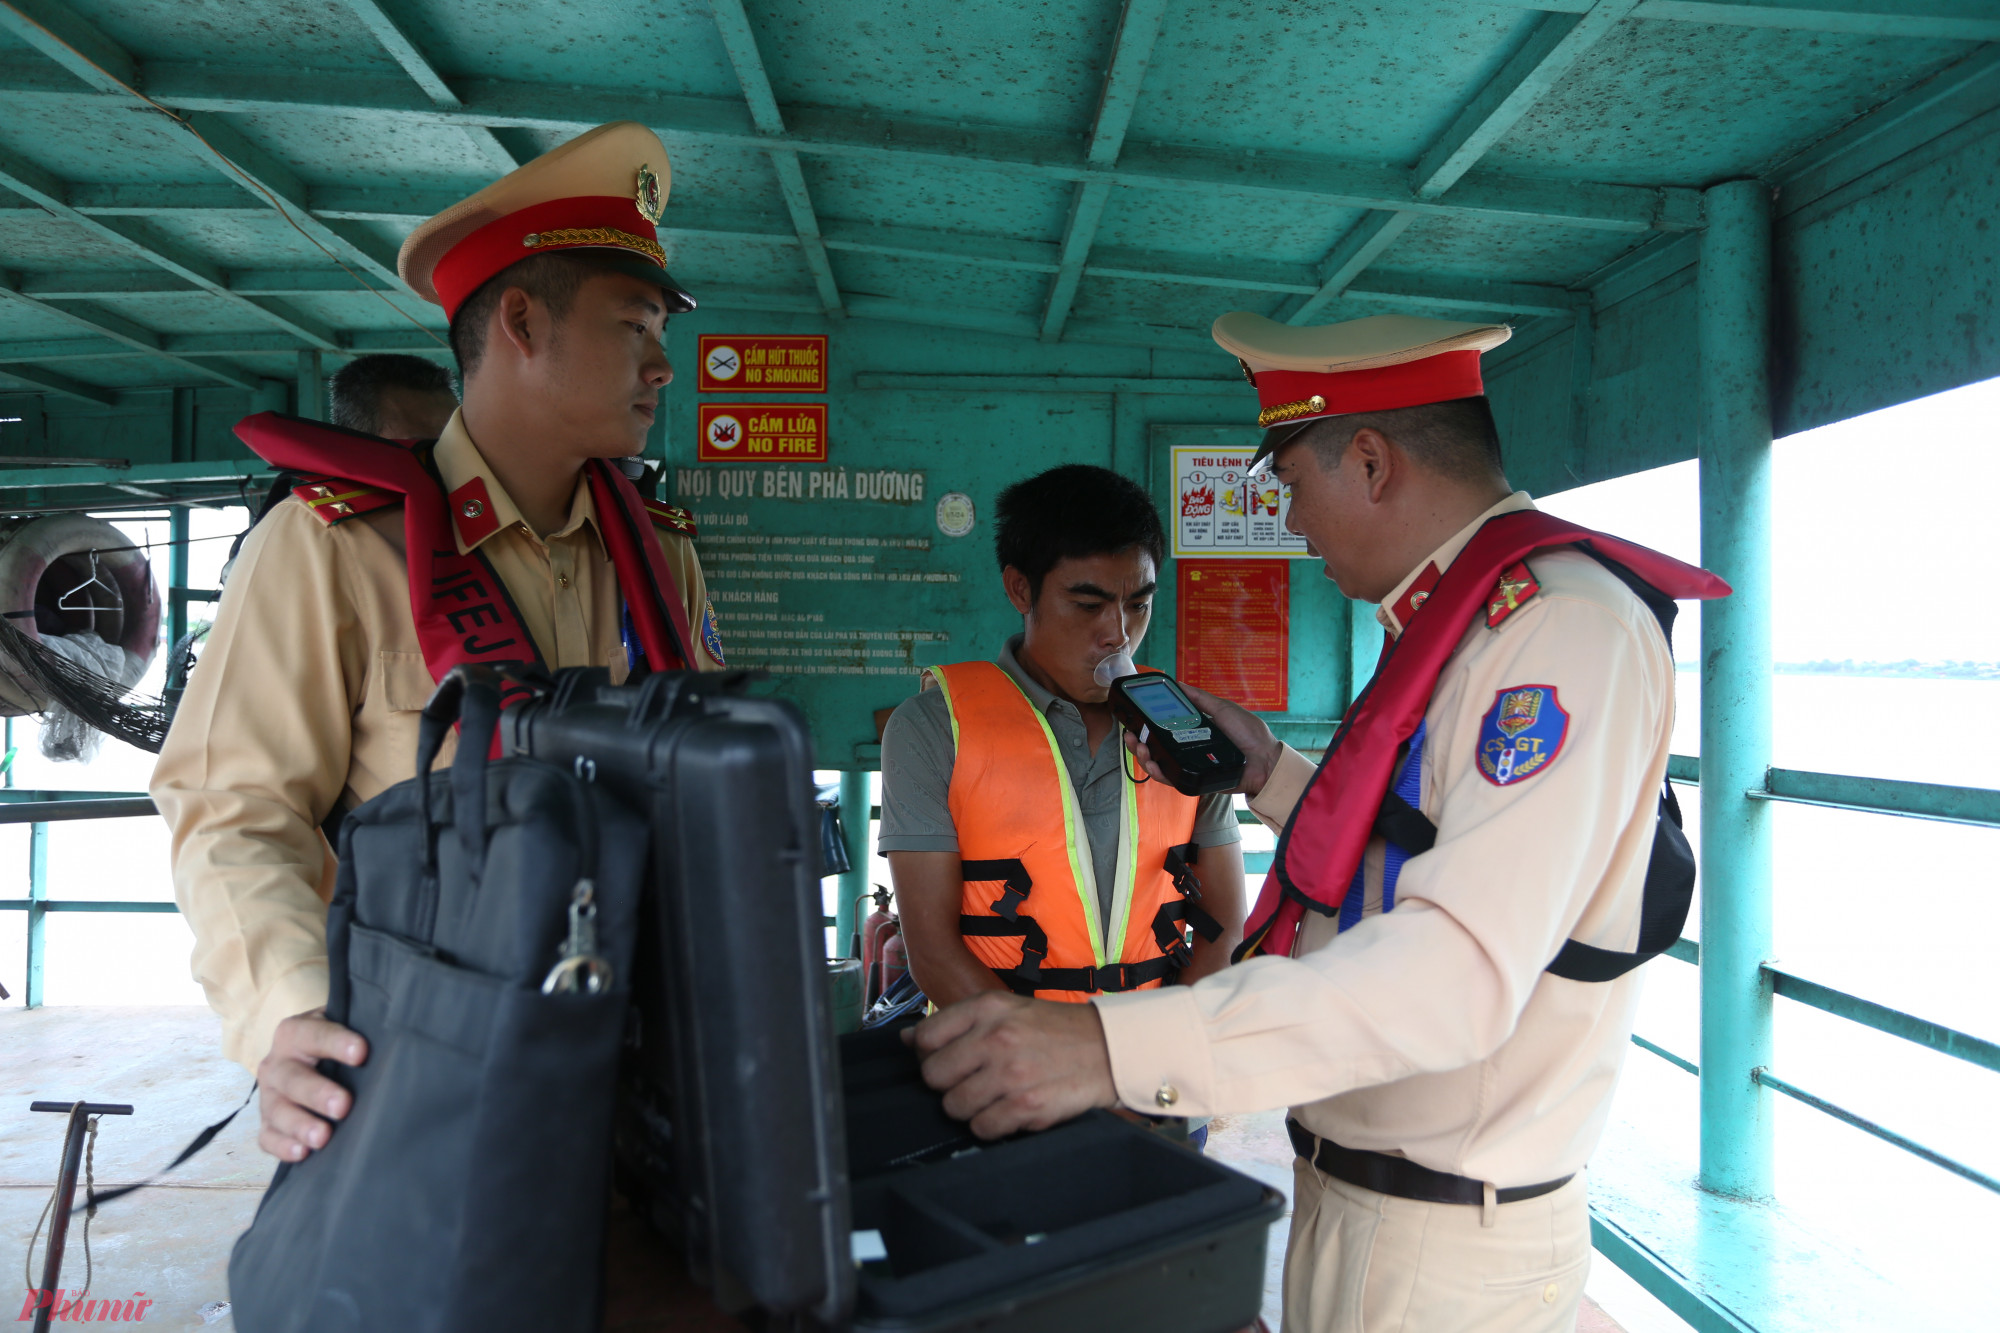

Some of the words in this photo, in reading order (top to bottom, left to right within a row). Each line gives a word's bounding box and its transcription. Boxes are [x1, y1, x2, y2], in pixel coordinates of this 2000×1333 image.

[744, 343, 766, 365] CẤM
[768, 346, 786, 366] HÚT
[788, 343, 819, 366] THUỐC
[745, 368, 762, 383] NO
[765, 368, 819, 383] SMOKING
[748, 412, 783, 433] CẤM
[788, 413, 817, 433] LỬA
[748, 438, 773, 453] NO
[779, 438, 817, 453] FIRE
[1192, 456, 1214, 466] TIÊU
[1216, 456, 1242, 468] LỆNH
[719, 469, 757, 500] QUY
[809, 466, 849, 499] PHÀ
[856, 470, 923, 501] DƯƠNG
[1195, 473, 1200, 482] 1
[1227, 473, 1234, 482] 2
[1259, 474, 1266, 482] 3
[1188, 494, 1205, 504] BÁO
[1185, 504, 1211, 517] ĐỘNG
[721, 588, 752, 602] KHÁCH
[1484, 736, 1507, 753] CS
[1515, 736, 1545, 752] GT
